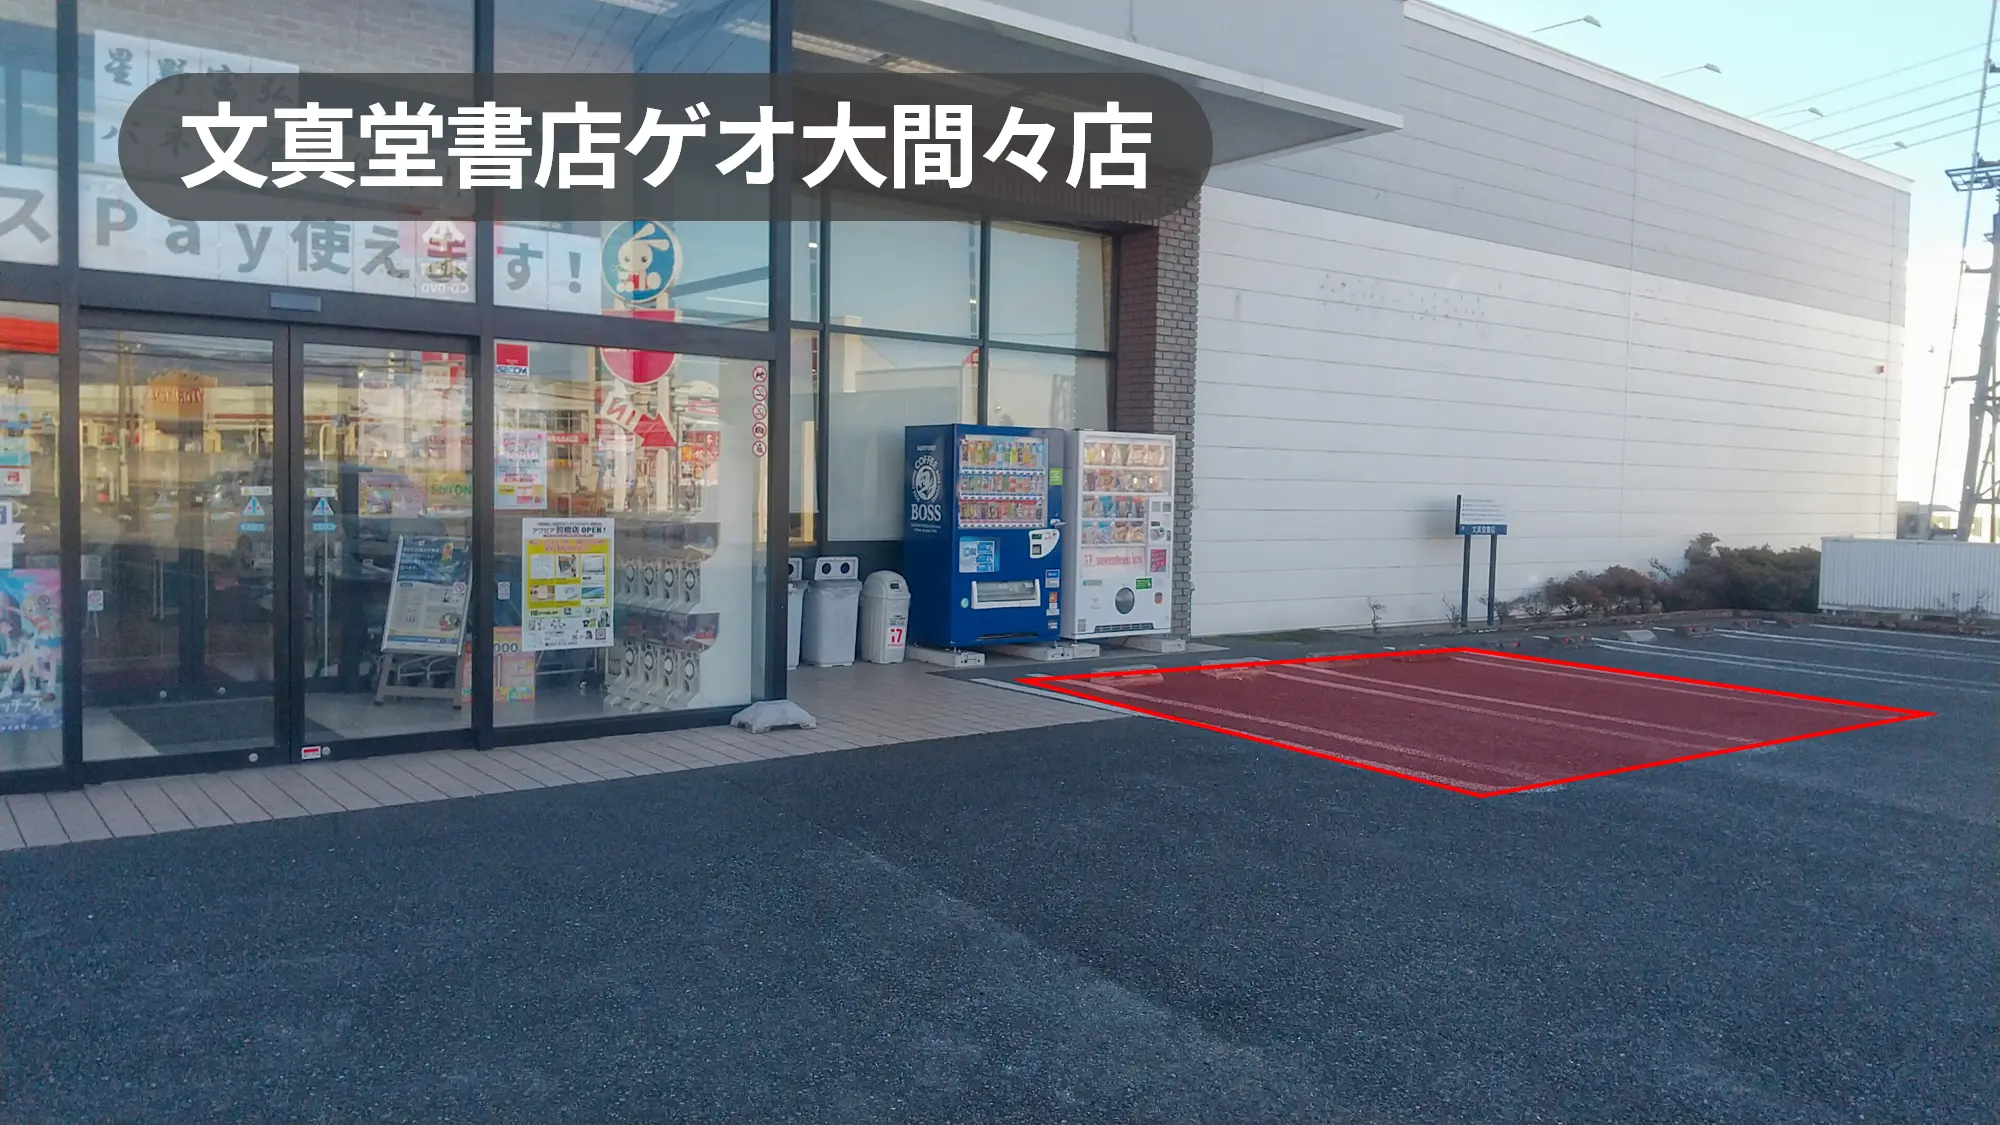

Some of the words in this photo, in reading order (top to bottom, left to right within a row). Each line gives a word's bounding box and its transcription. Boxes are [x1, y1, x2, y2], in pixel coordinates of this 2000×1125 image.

[914, 455, 938, 469] COFFEE
[911, 504, 941, 521] BOSS
[1096, 554, 1131, 566] seventeen
[890, 628, 904, 643] i7
